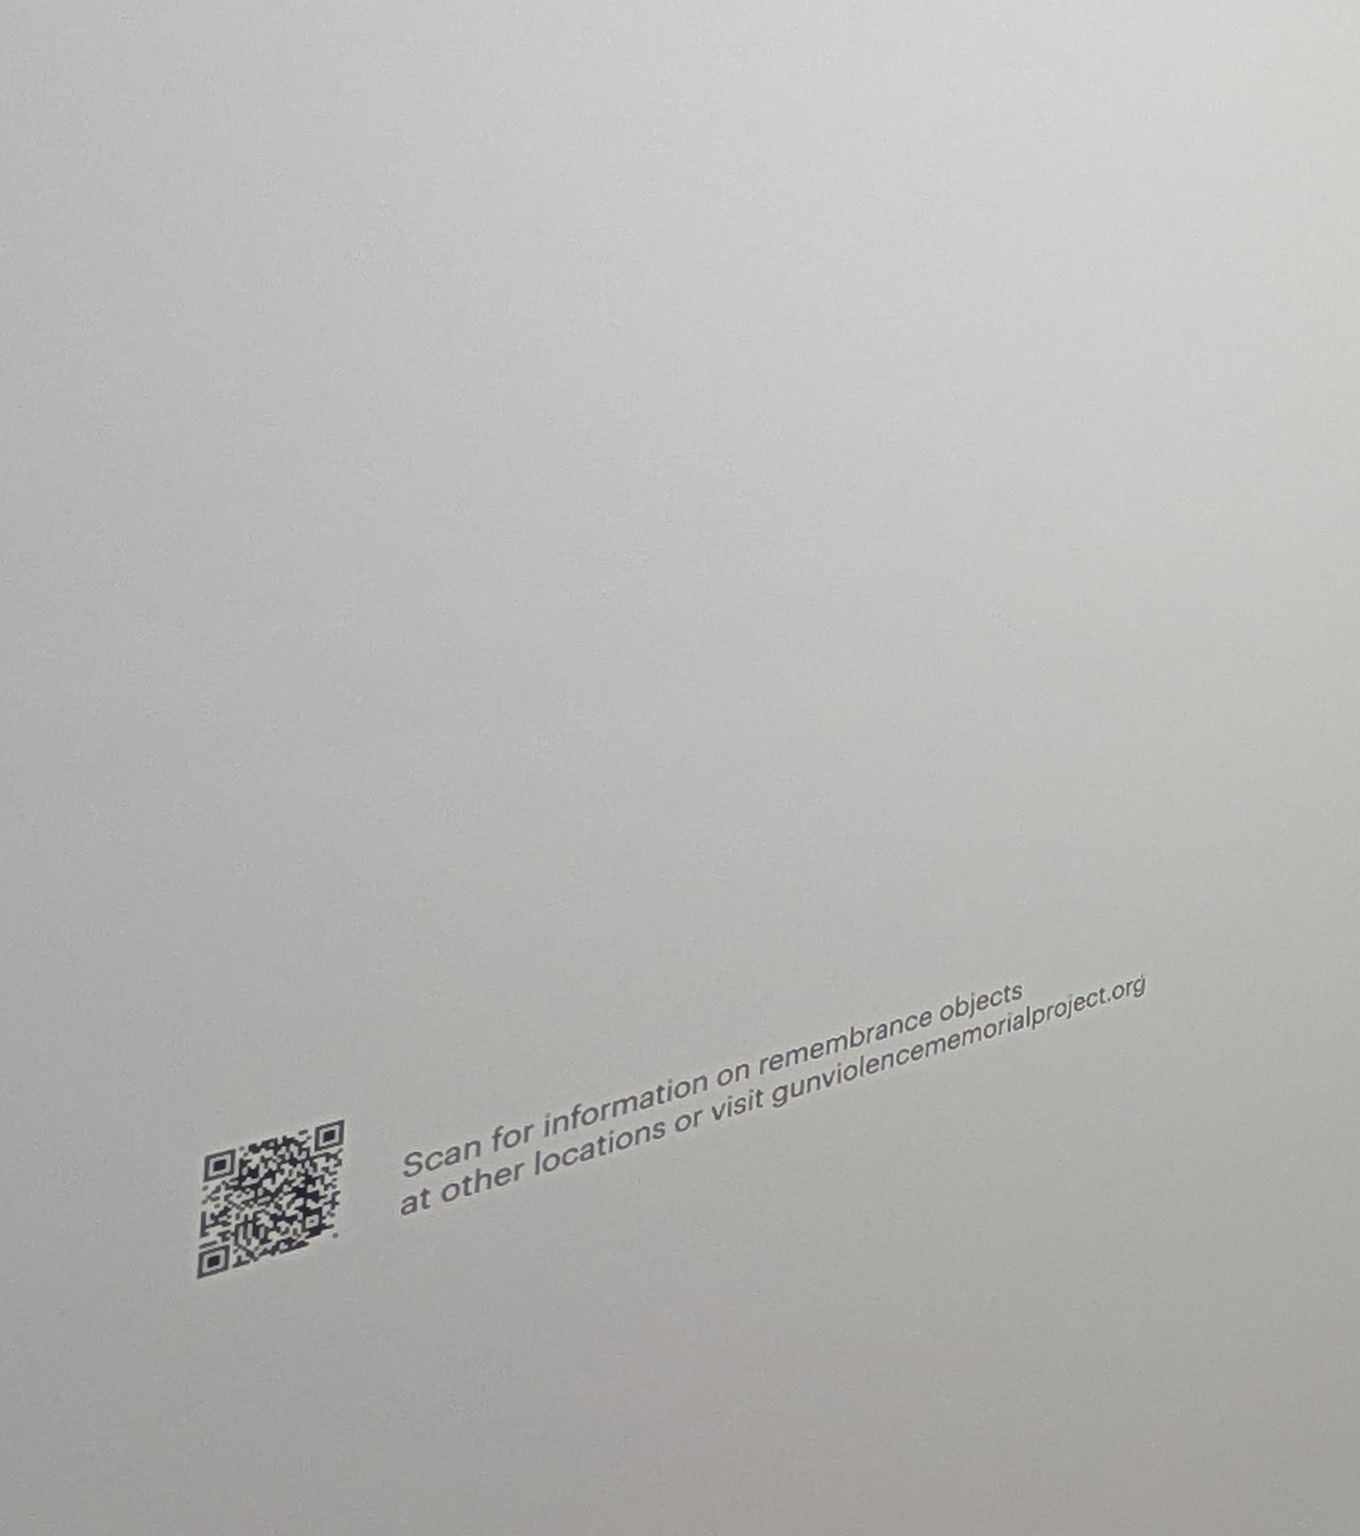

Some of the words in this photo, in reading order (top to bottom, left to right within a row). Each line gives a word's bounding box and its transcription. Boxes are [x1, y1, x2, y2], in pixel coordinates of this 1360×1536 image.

[400, 1187, 432, 1217] at
[440, 1162, 525, 1203] other
[534, 1120, 667, 1176] locations
[674, 1109, 710, 1133] or
[711, 1088, 765, 1122] visit
[771, 973, 1146, 1109] gunviolencememorialproject.org
[402, 1139, 482, 1178] Scan
[490, 1123, 536, 1153] for
[542, 1075, 709, 1139] information
[716, 1063, 751, 1088] on
[758, 1010, 933, 1076] remembrance
[939, 984, 1023, 1022] objects
